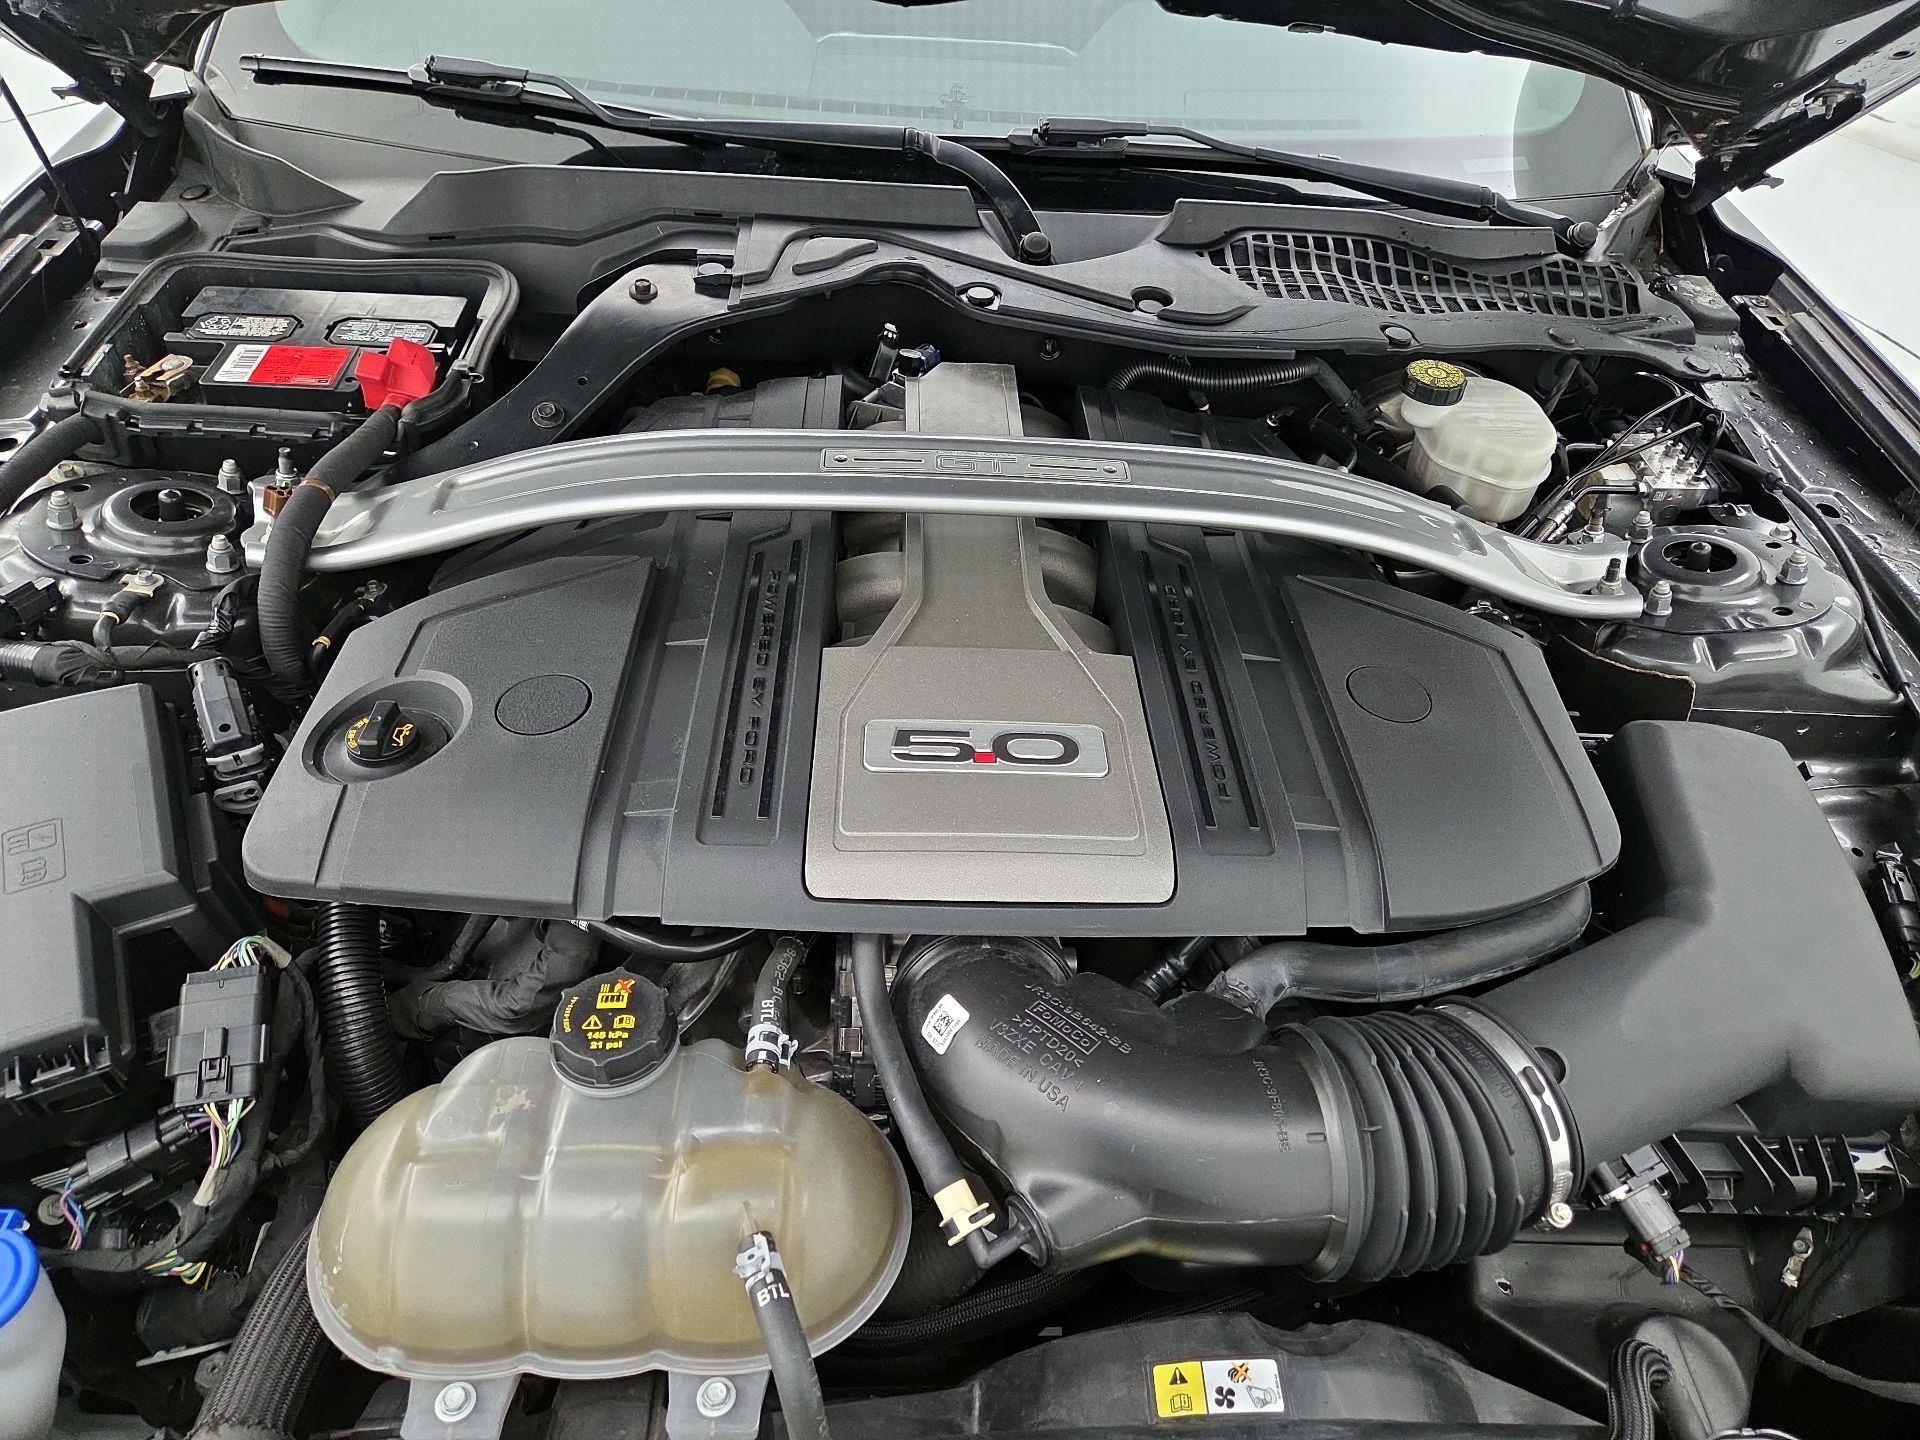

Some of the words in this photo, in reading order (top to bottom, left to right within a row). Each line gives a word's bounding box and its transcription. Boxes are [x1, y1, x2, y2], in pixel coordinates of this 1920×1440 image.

[934, 454, 1018, 475] GT
[756, 569, 782, 669] POWERED
[1164, 585, 1189, 638] FORD
[1180, 644, 1198, 674] BY
[751, 676, 766, 708] BY
[739, 716, 761, 786] FORD
[890, 727, 1081, 767] 5.0
[1189, 680, 1232, 802] POWERED
[760, 999, 775, 1023] BTL
[1032, 1004, 1092, 1048] FoMoCo
[586, 1031, 607, 1040] 145
[607, 1030, 629, 1039] kPa
[589, 1041, 604, 1050] 21
[605, 1040, 623, 1051] psi
[974, 1033, 1021, 1070] MADE
[1020, 1064, 1039, 1083] IN
[1037, 1076, 1070, 1113] USA
[1039, 1053, 1075, 1080] CAV
[756, 1282, 790, 1308] BTL
